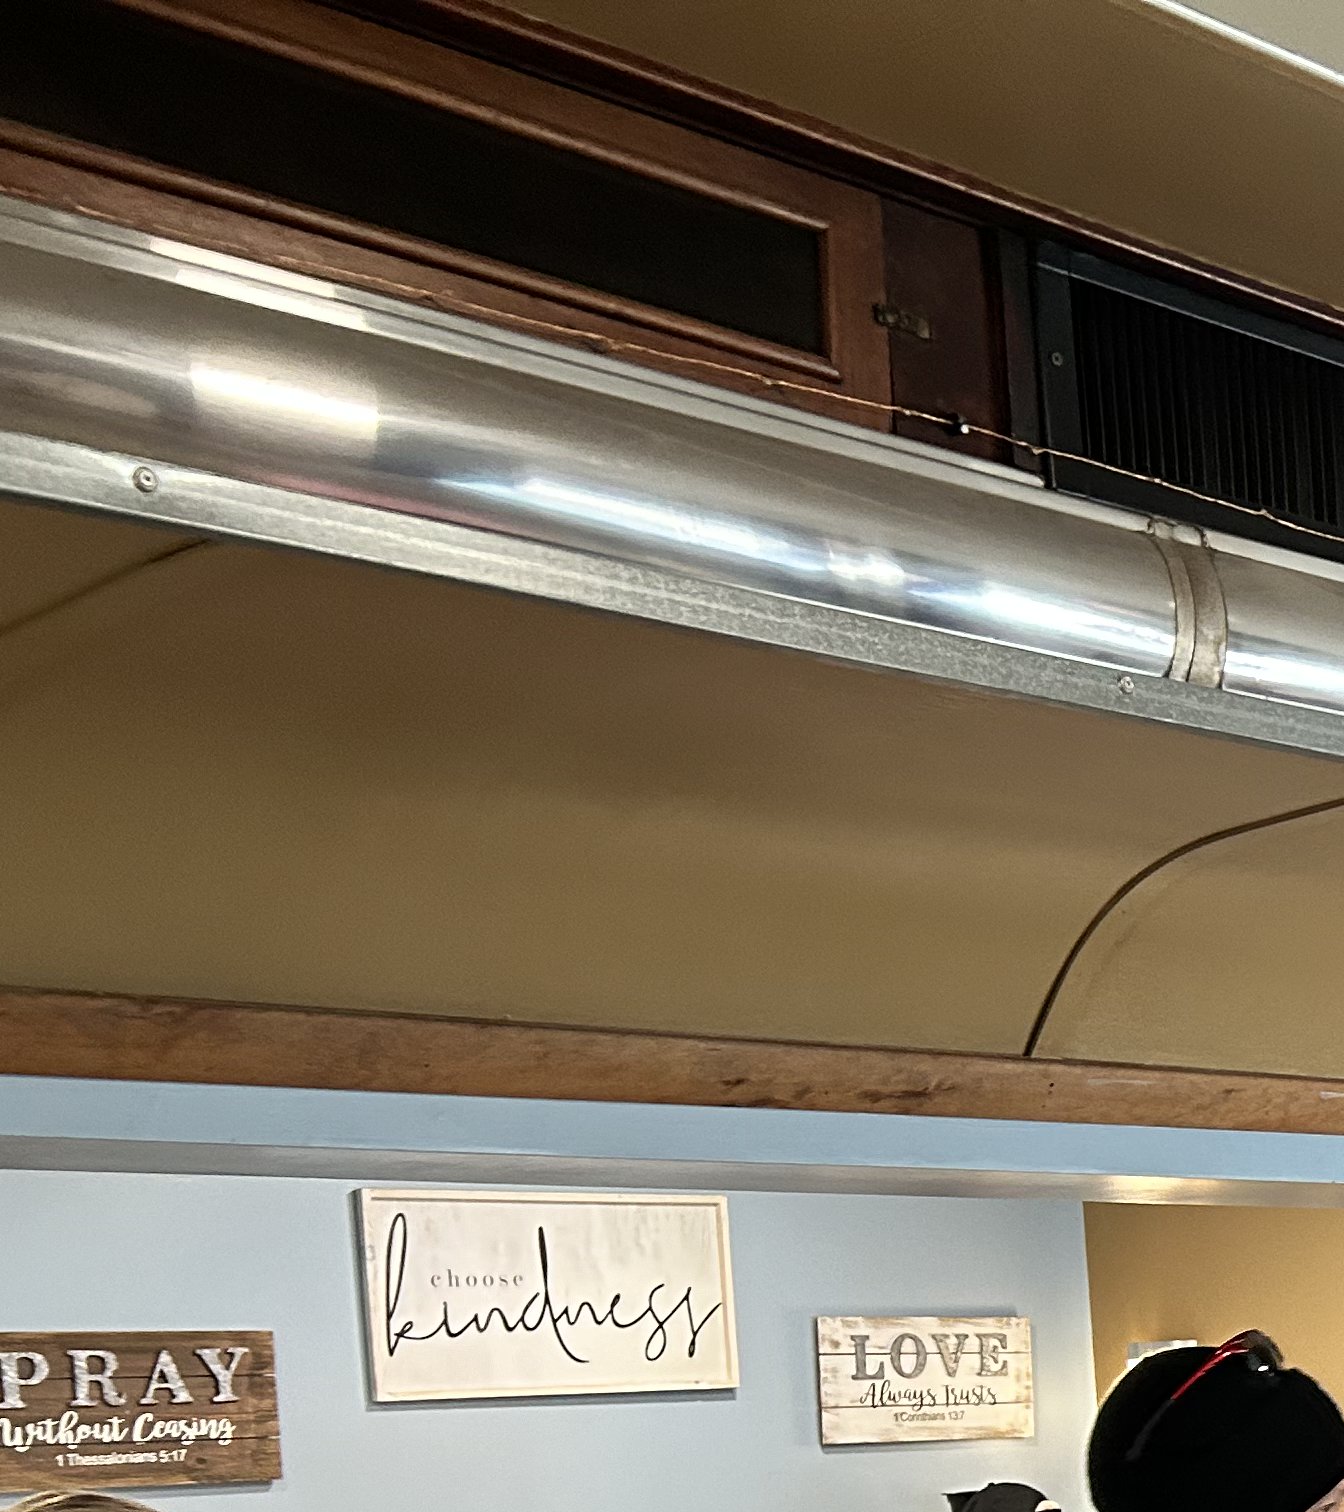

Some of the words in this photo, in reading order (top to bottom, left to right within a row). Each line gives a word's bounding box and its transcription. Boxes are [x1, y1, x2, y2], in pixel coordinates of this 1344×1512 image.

[385, 1212, 724, 1363] kindness
[430, 1268, 525, 1289] choose
[850, 1332, 1009, 1381] LOVE
[0, 1346, 250, 1411] PRAY
[859, 1379, 937, 1411] Always
[943, 1384, 998, 1408] Trusts
[0, 1410, 129, 1453] Without
[132, 1412, 237, 1447] Ceasing
[55, 1453, 64, 1467] 1
[67, 1451, 158, 1467] Thessalonians
[159, 1448, 188, 1463] 5:17
